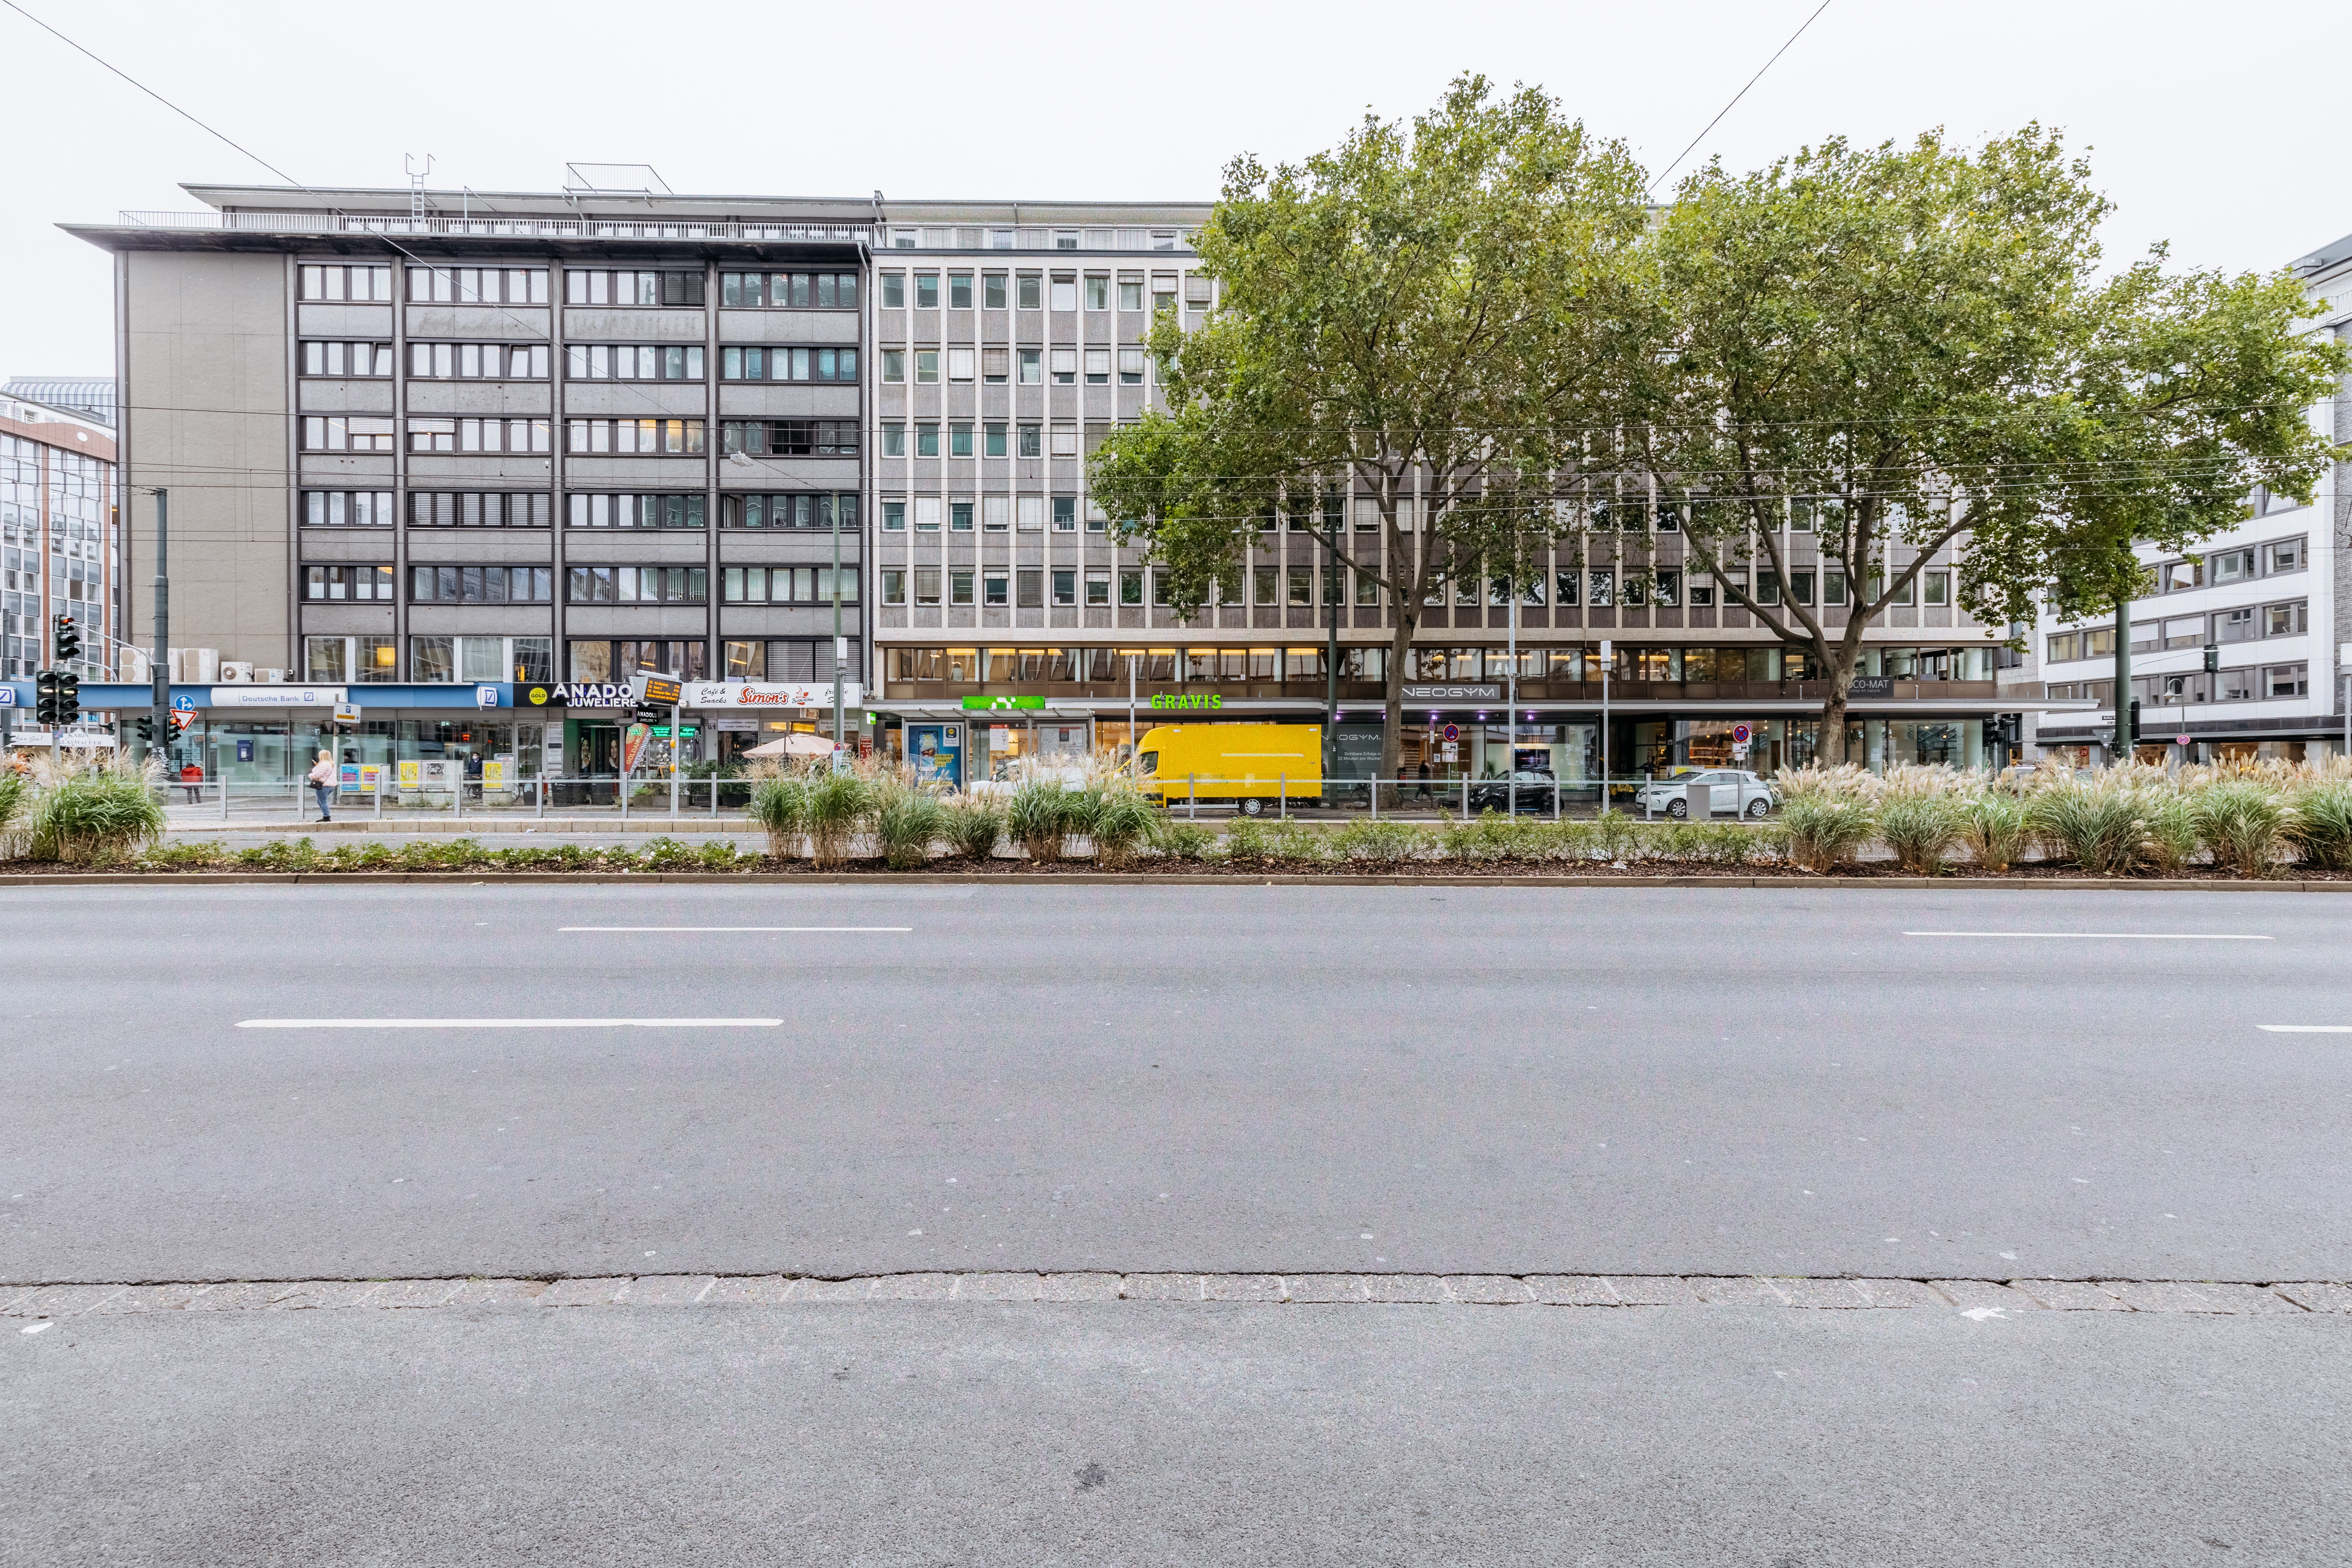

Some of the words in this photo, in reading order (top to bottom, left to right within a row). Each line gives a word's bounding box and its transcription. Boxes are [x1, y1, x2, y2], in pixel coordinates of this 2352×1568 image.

[1849, 680, 1889, 688] CO-MAT
[552, 682, 632, 698] ANADO
[737, 686, 789, 705] Simon's
[1402, 687, 1494, 696] NEOGYM
[567, 698, 638, 707] JUWELIERE
[1151, 695, 1222, 709] GRAVIS
